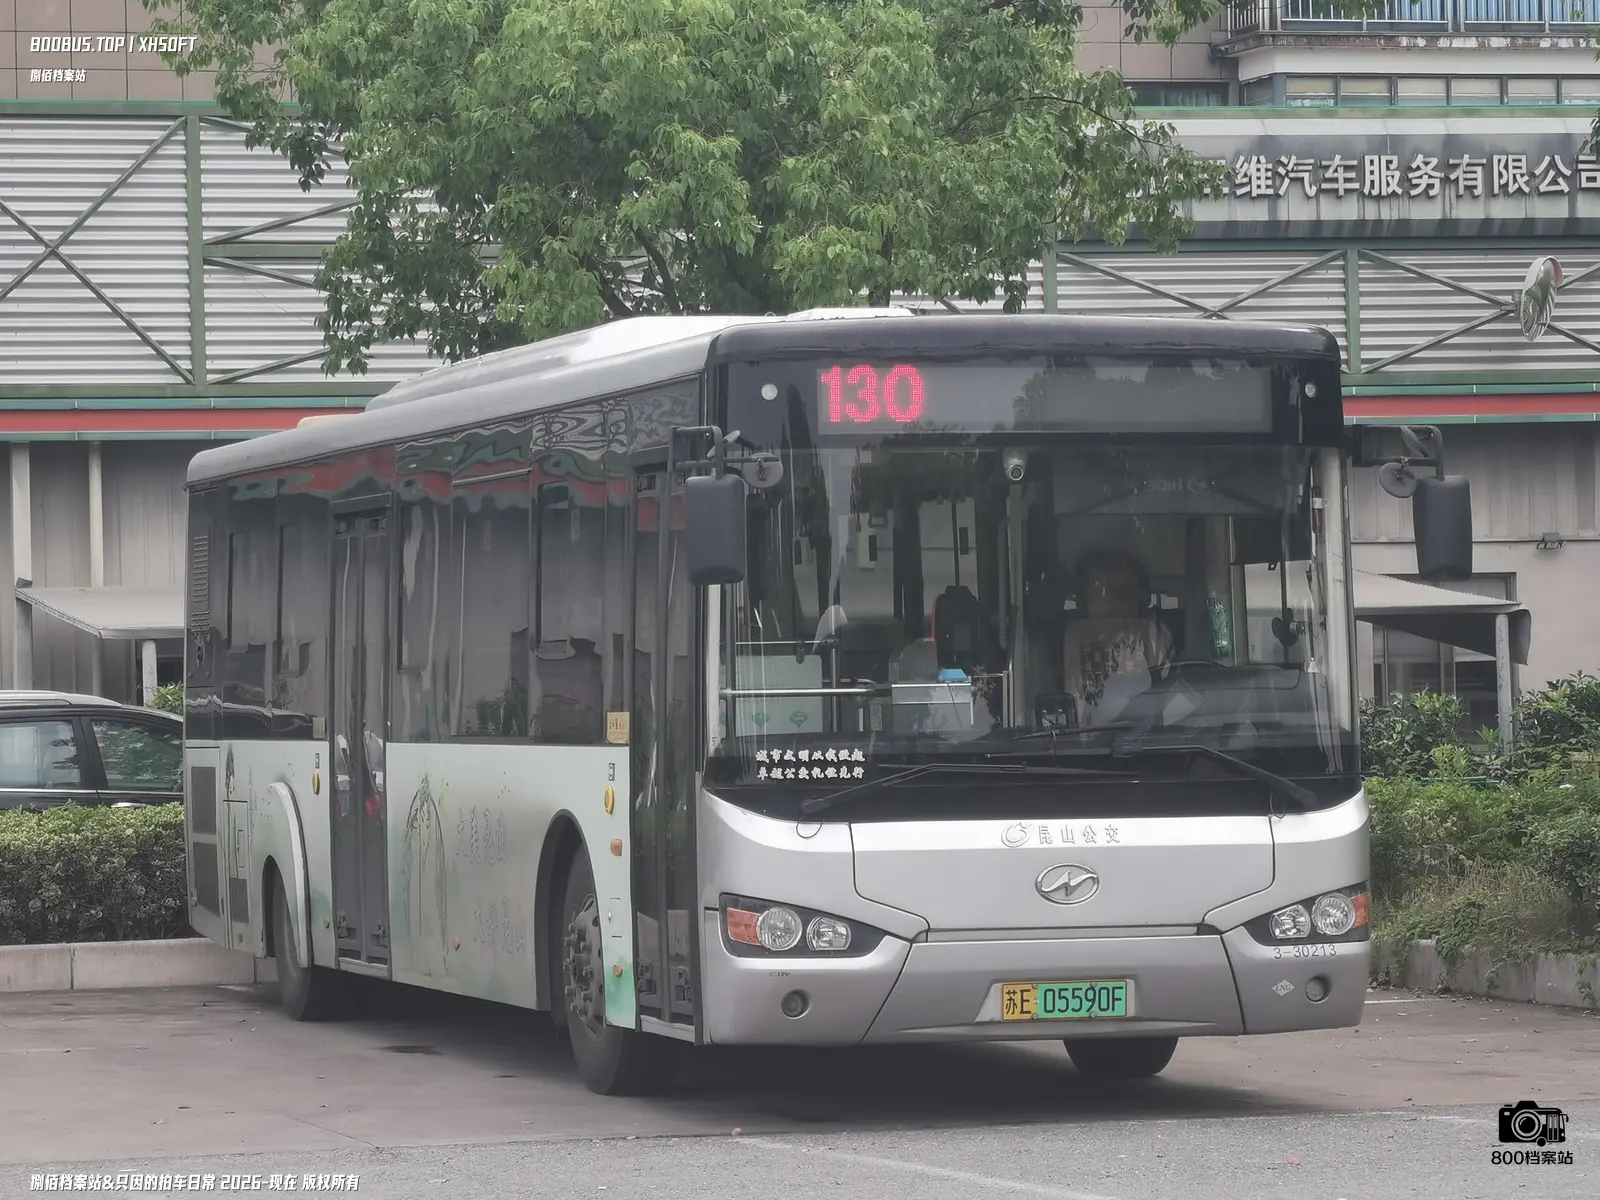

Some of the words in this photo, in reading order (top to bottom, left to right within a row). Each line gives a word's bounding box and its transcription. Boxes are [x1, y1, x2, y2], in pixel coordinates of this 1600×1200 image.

[1190, 153, 1600, 198] 维汽车服务有限公司
[820, 364, 924, 423] 130
[1038, 824, 1120, 845] 昆山公交
[1273, 944, 1336, 960] 3-30213
[1005, 987, 1032, 1015] 苏E
[1043, 986, 1124, 1014] 05590F
